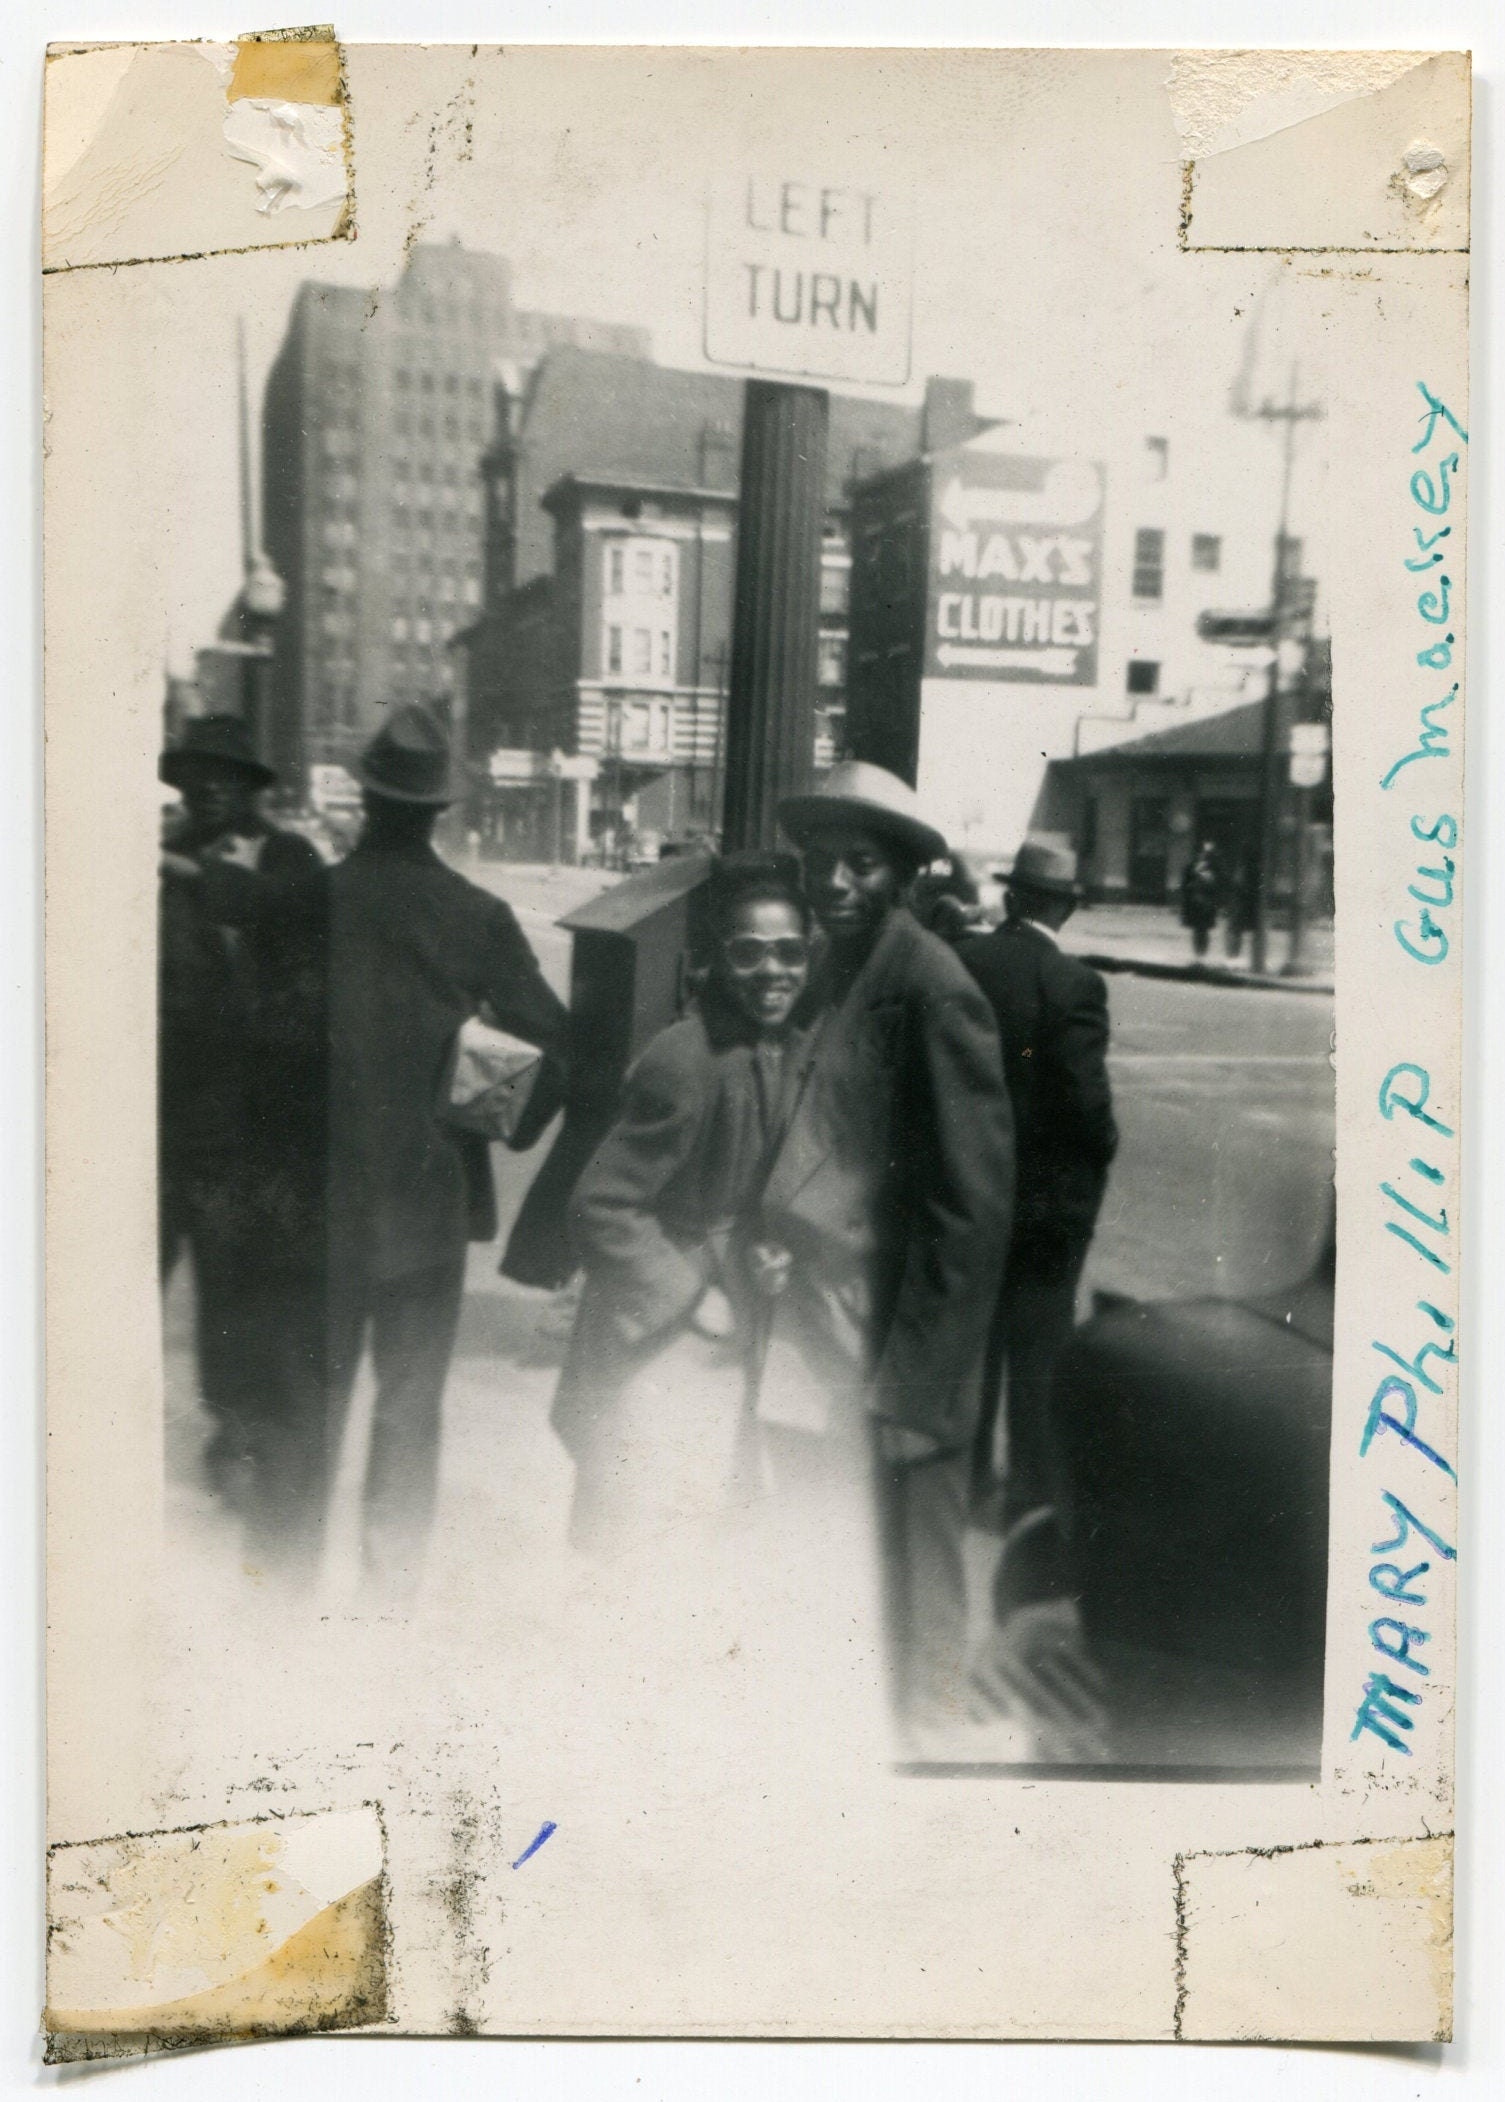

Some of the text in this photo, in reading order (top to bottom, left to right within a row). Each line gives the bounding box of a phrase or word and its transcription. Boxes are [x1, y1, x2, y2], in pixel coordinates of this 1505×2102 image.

[746, 174, 879, 246] LEFT
[743, 262, 878, 334] TURN
[937, 592, 1096, 645] CLOTHES
[1350, 1489, 1457, 1755] MARY
